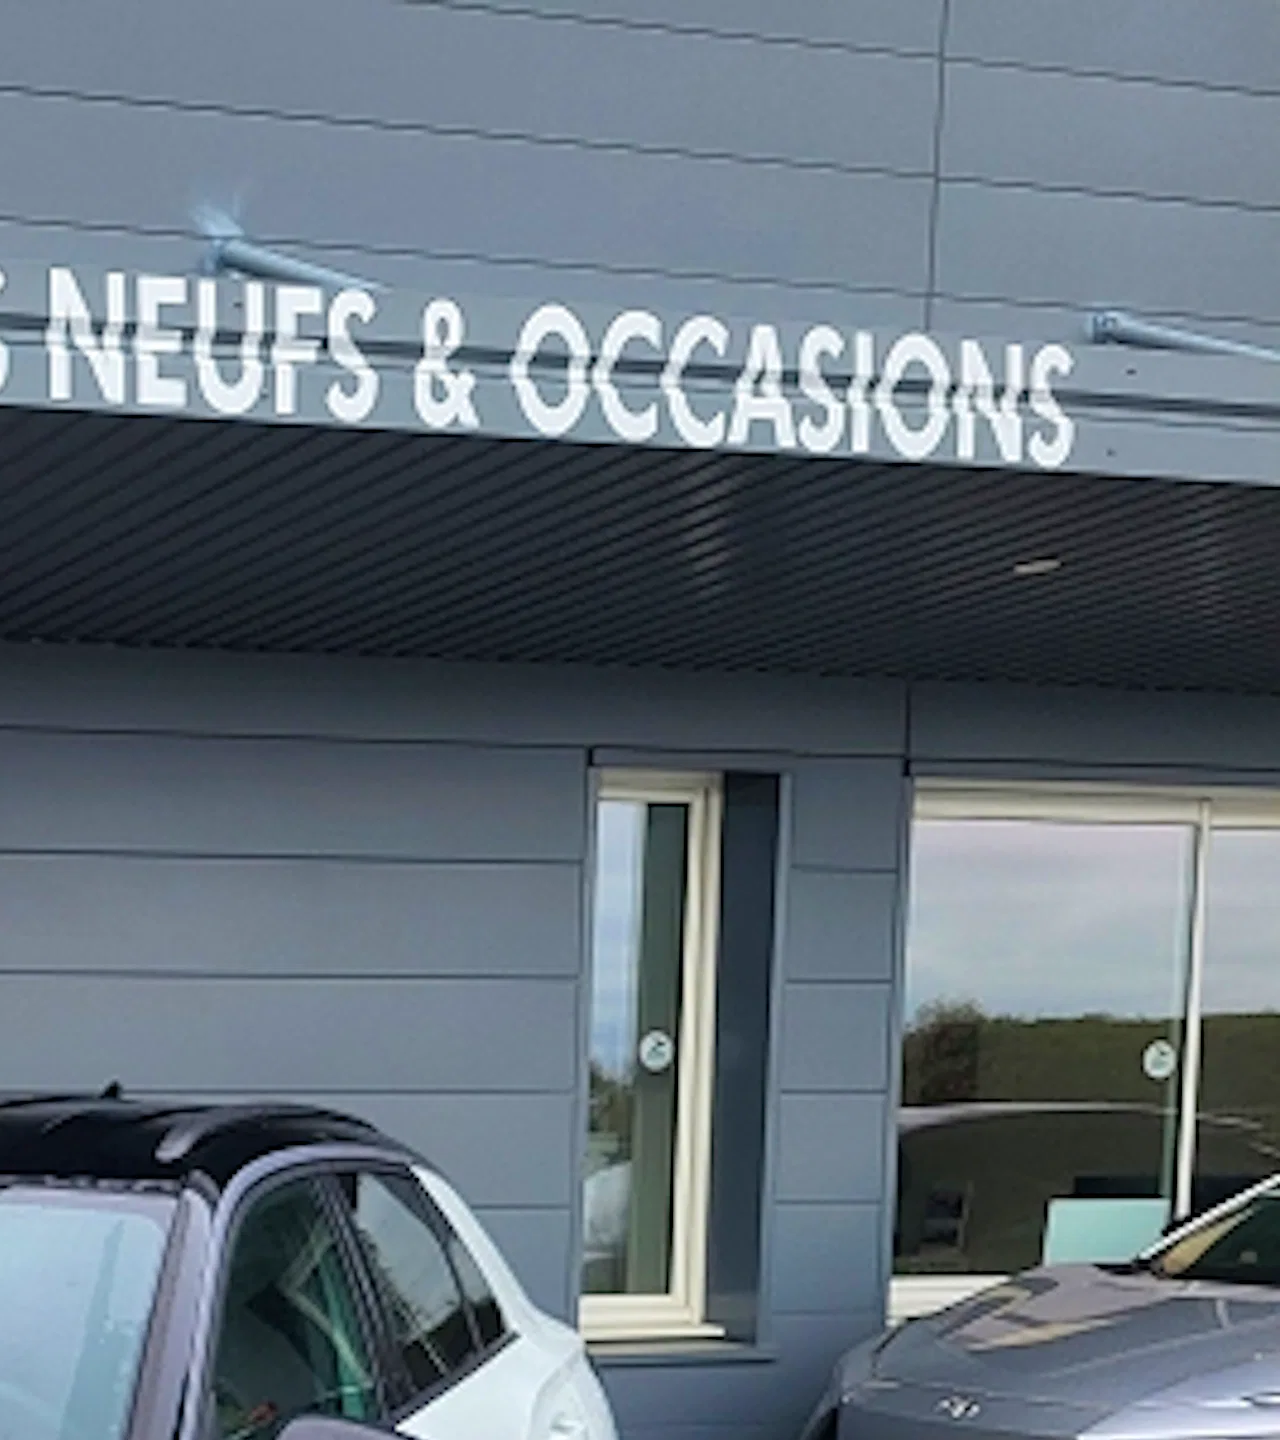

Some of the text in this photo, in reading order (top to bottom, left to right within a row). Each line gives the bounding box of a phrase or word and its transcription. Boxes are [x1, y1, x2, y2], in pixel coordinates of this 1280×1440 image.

[45, 265, 380, 424] NEUFS
[413, 298, 481, 429] &
[510, 303, 1077, 469] OCCASIONS
